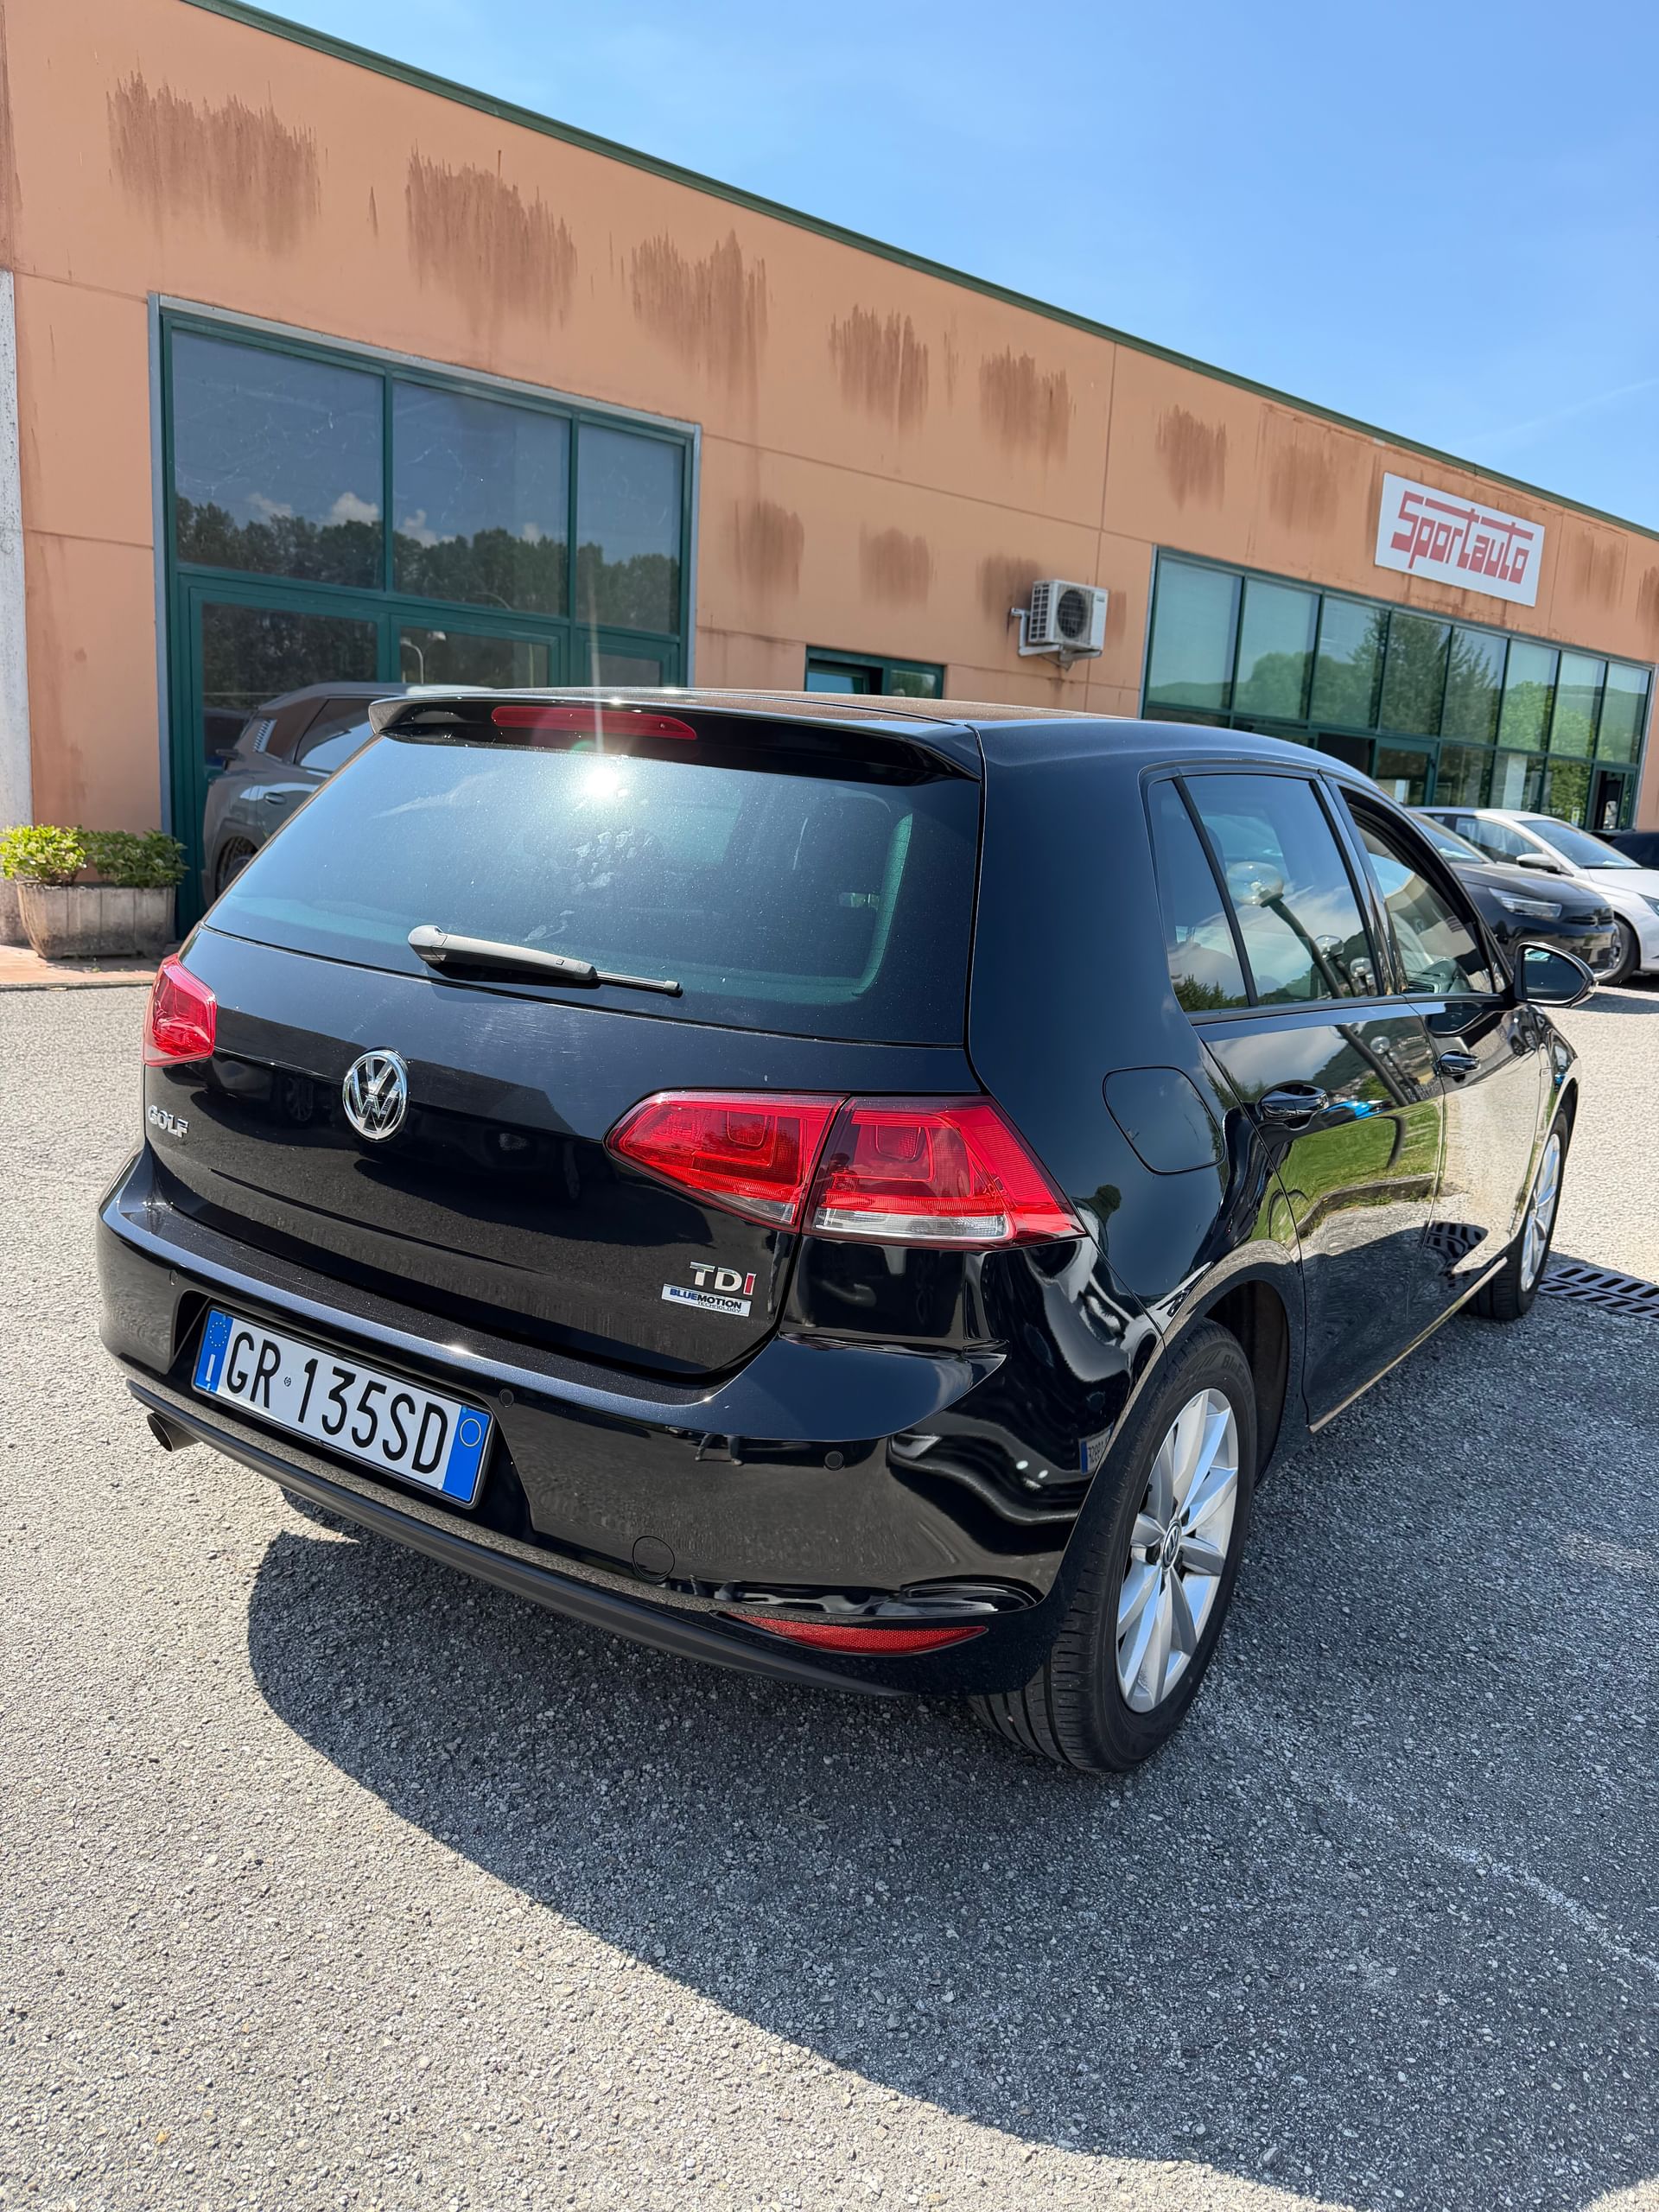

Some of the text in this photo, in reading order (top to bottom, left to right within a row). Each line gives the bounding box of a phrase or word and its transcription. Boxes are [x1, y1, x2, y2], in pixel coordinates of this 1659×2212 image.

[1390, 490, 1534, 584] Sportauto
[148, 1105, 188, 1138] GOLF
[690, 1262, 756, 1295] TDI
[670, 1288, 741, 1309] BLUEMOTION
